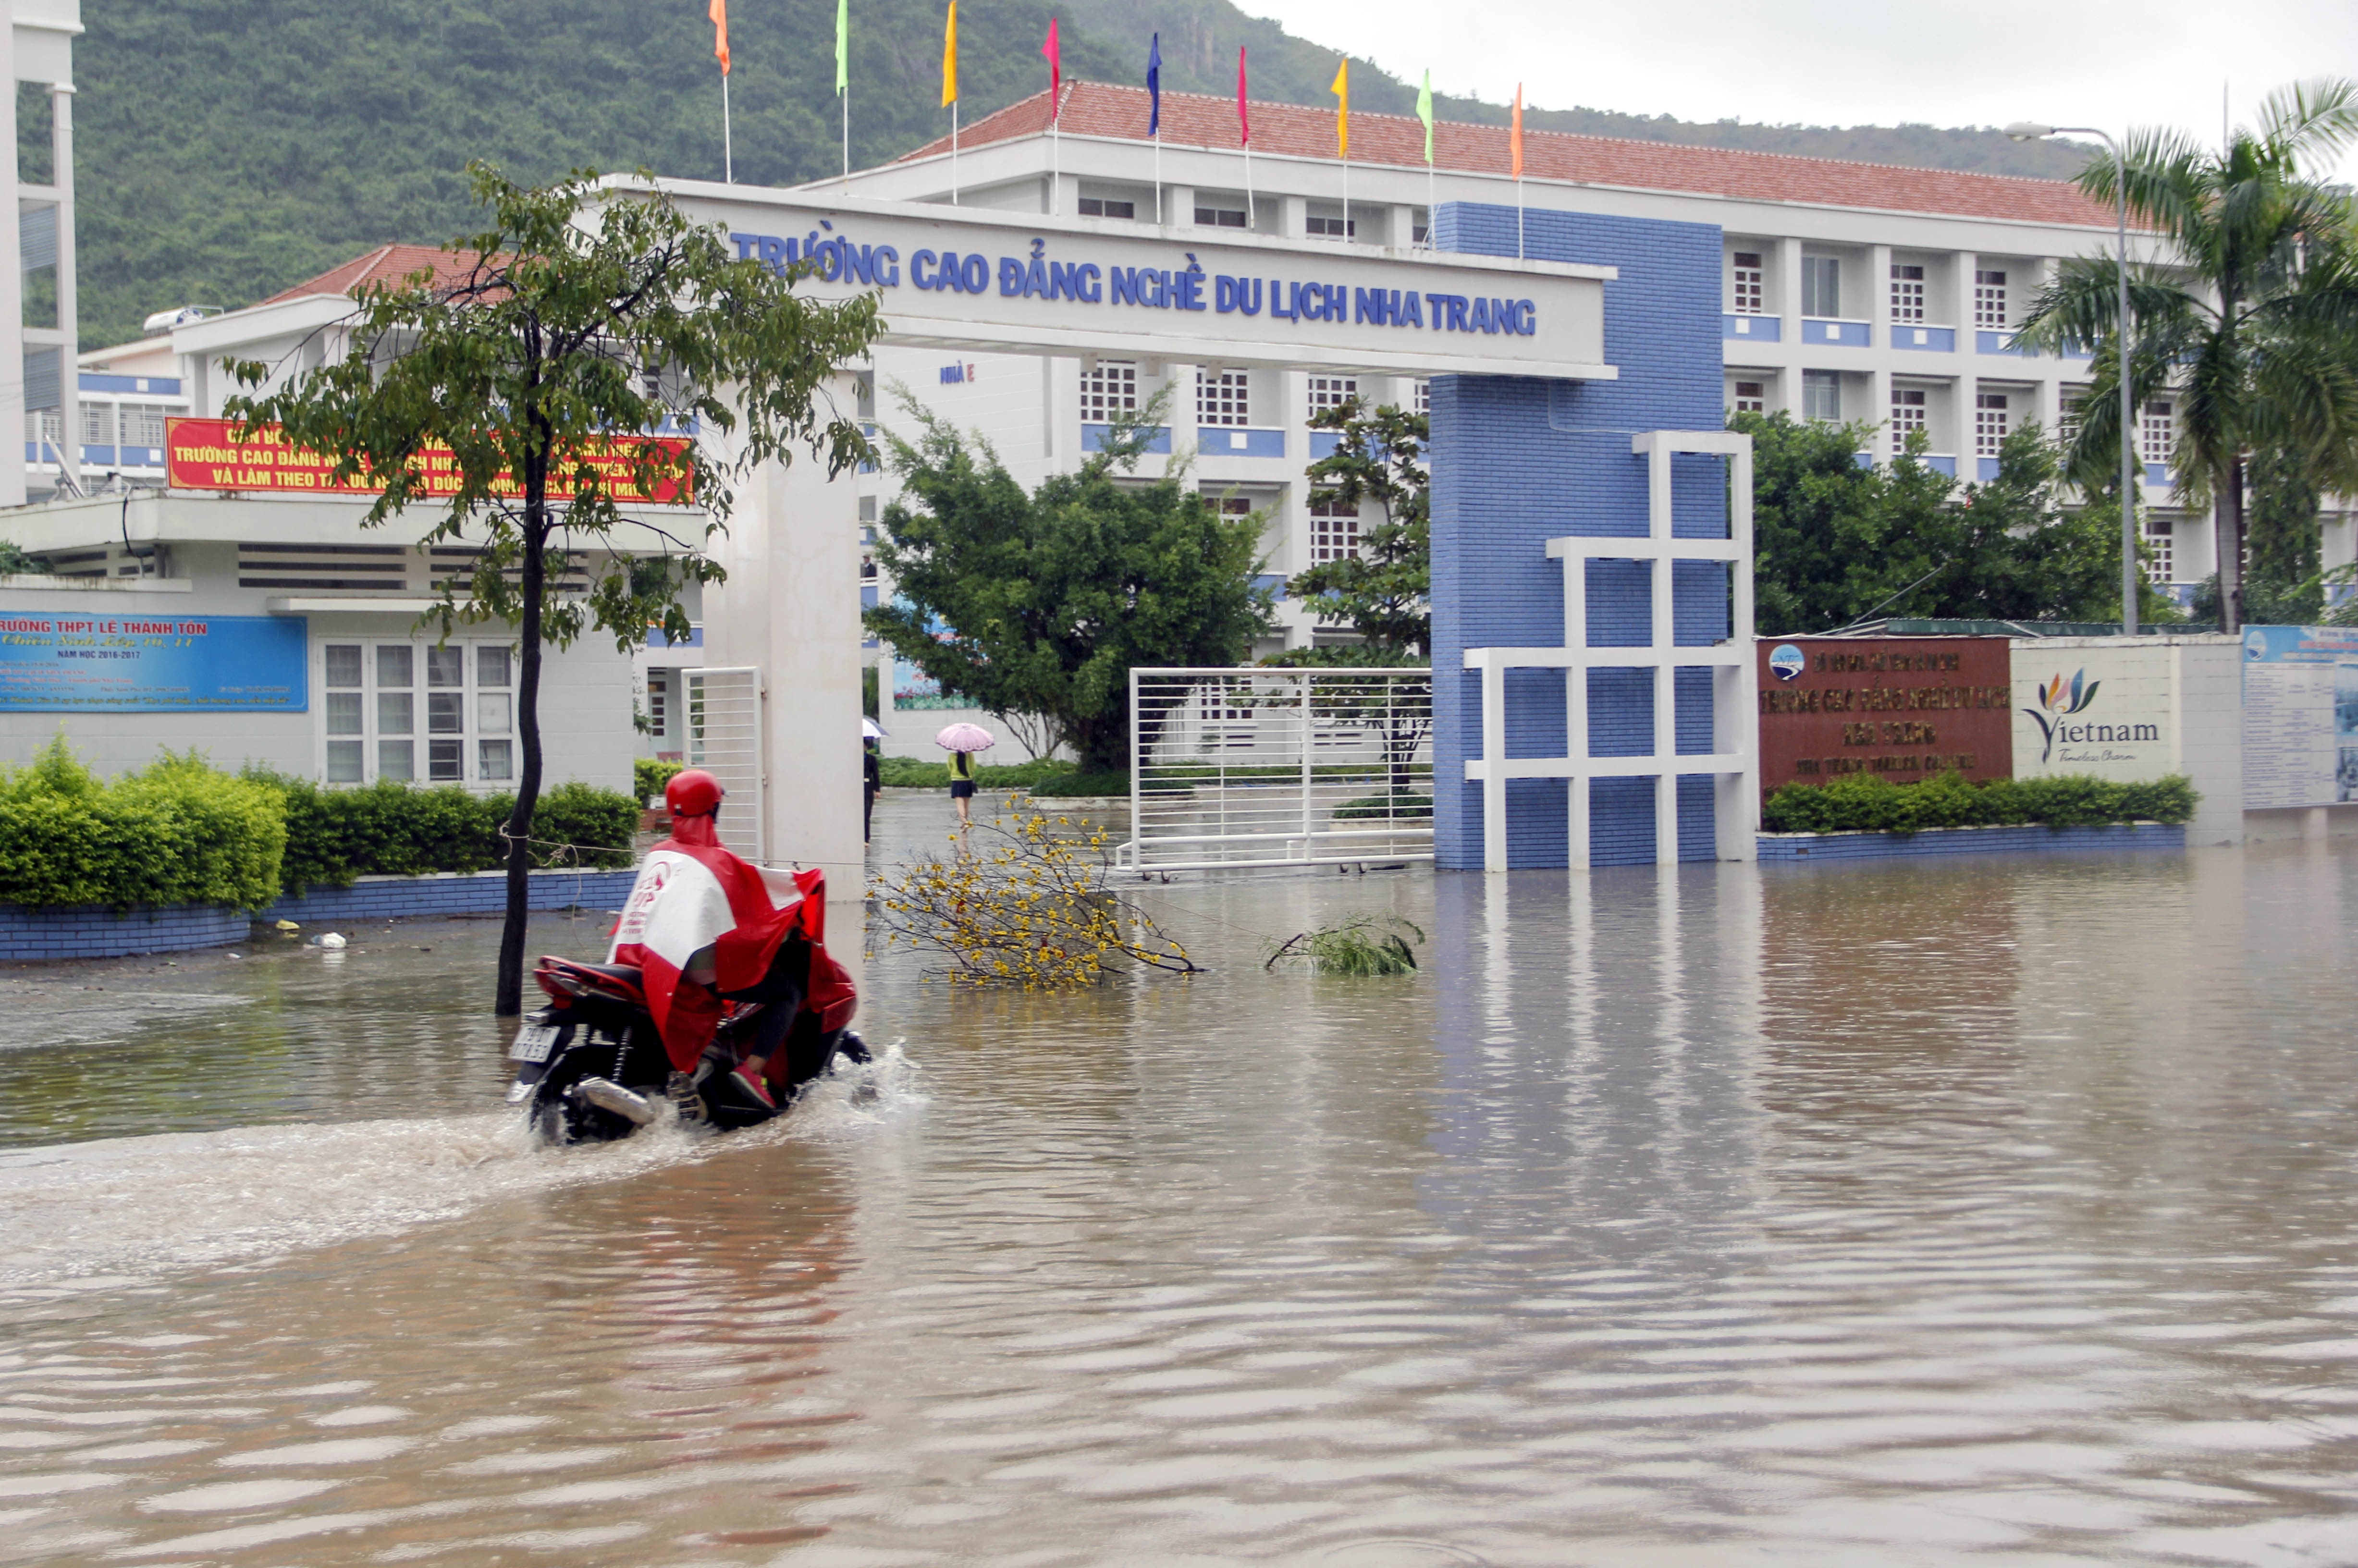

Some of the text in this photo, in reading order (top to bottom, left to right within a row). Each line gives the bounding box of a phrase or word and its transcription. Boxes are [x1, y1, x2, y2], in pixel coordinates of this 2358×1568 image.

[730, 220, 1535, 335] TRƯỜNG CAO ĐẲNG NGHỀ DU LỊCH NHA TRANG
[967, 364, 975, 382] E
[174, 445, 238, 464] TRƯỜNG
[242, 450, 273, 465] CAO
[212, 466, 234, 484] VÀ
[237, 467, 271, 486] LÀM
[275, 471, 315, 487] THEO
[433, 473, 464, 491] ĐỨC
[56, 621, 94, 633] THPT
[99, 620, 118, 633] LÊ
[177, 620, 207, 635] TÔN
[175, 637, 193, 648] 11
[58, 650, 141, 660] NĂM HỌC 2016-2017
[2020, 709, 2159, 764] Vietnam
[2101, 749, 2137, 761] Charm
